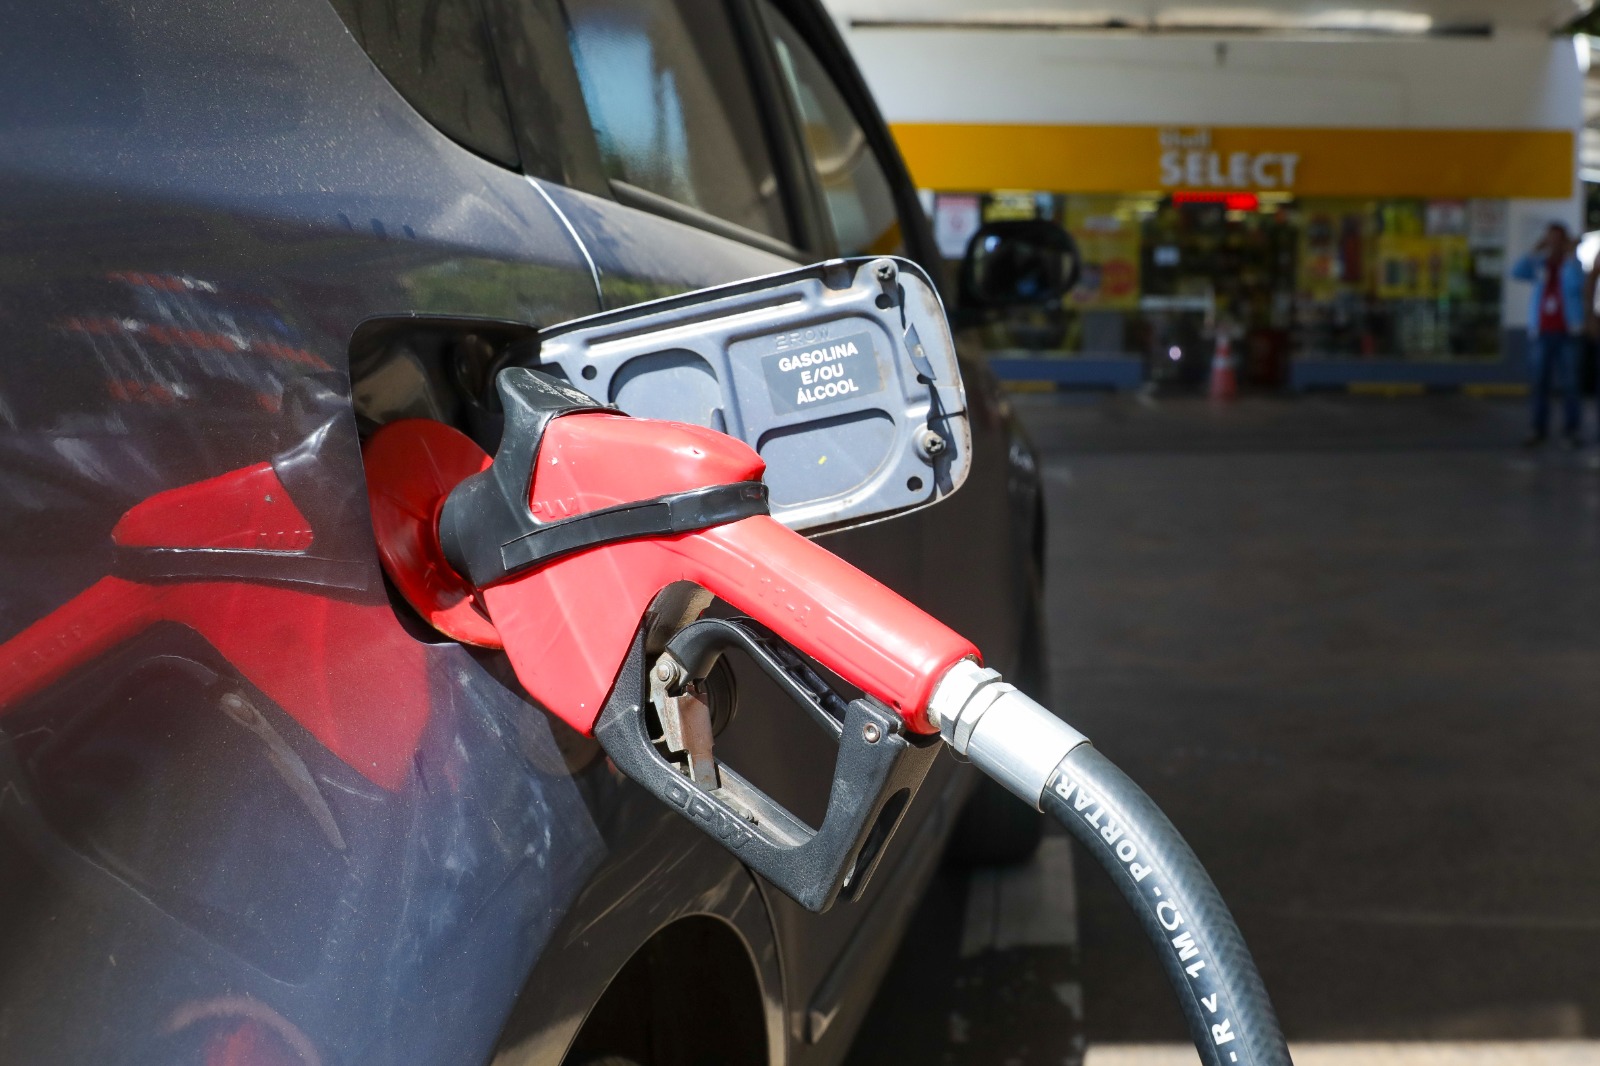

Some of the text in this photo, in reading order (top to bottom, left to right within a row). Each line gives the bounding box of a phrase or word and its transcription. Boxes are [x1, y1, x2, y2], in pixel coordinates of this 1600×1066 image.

[1160, 152, 1299, 188] SELECT
[779, 342, 858, 372] GASOLINA
[801, 363, 844, 385] E/OU
[797, 379, 859, 405] ÁLCOOL
[663, 776, 753, 850] OPW
